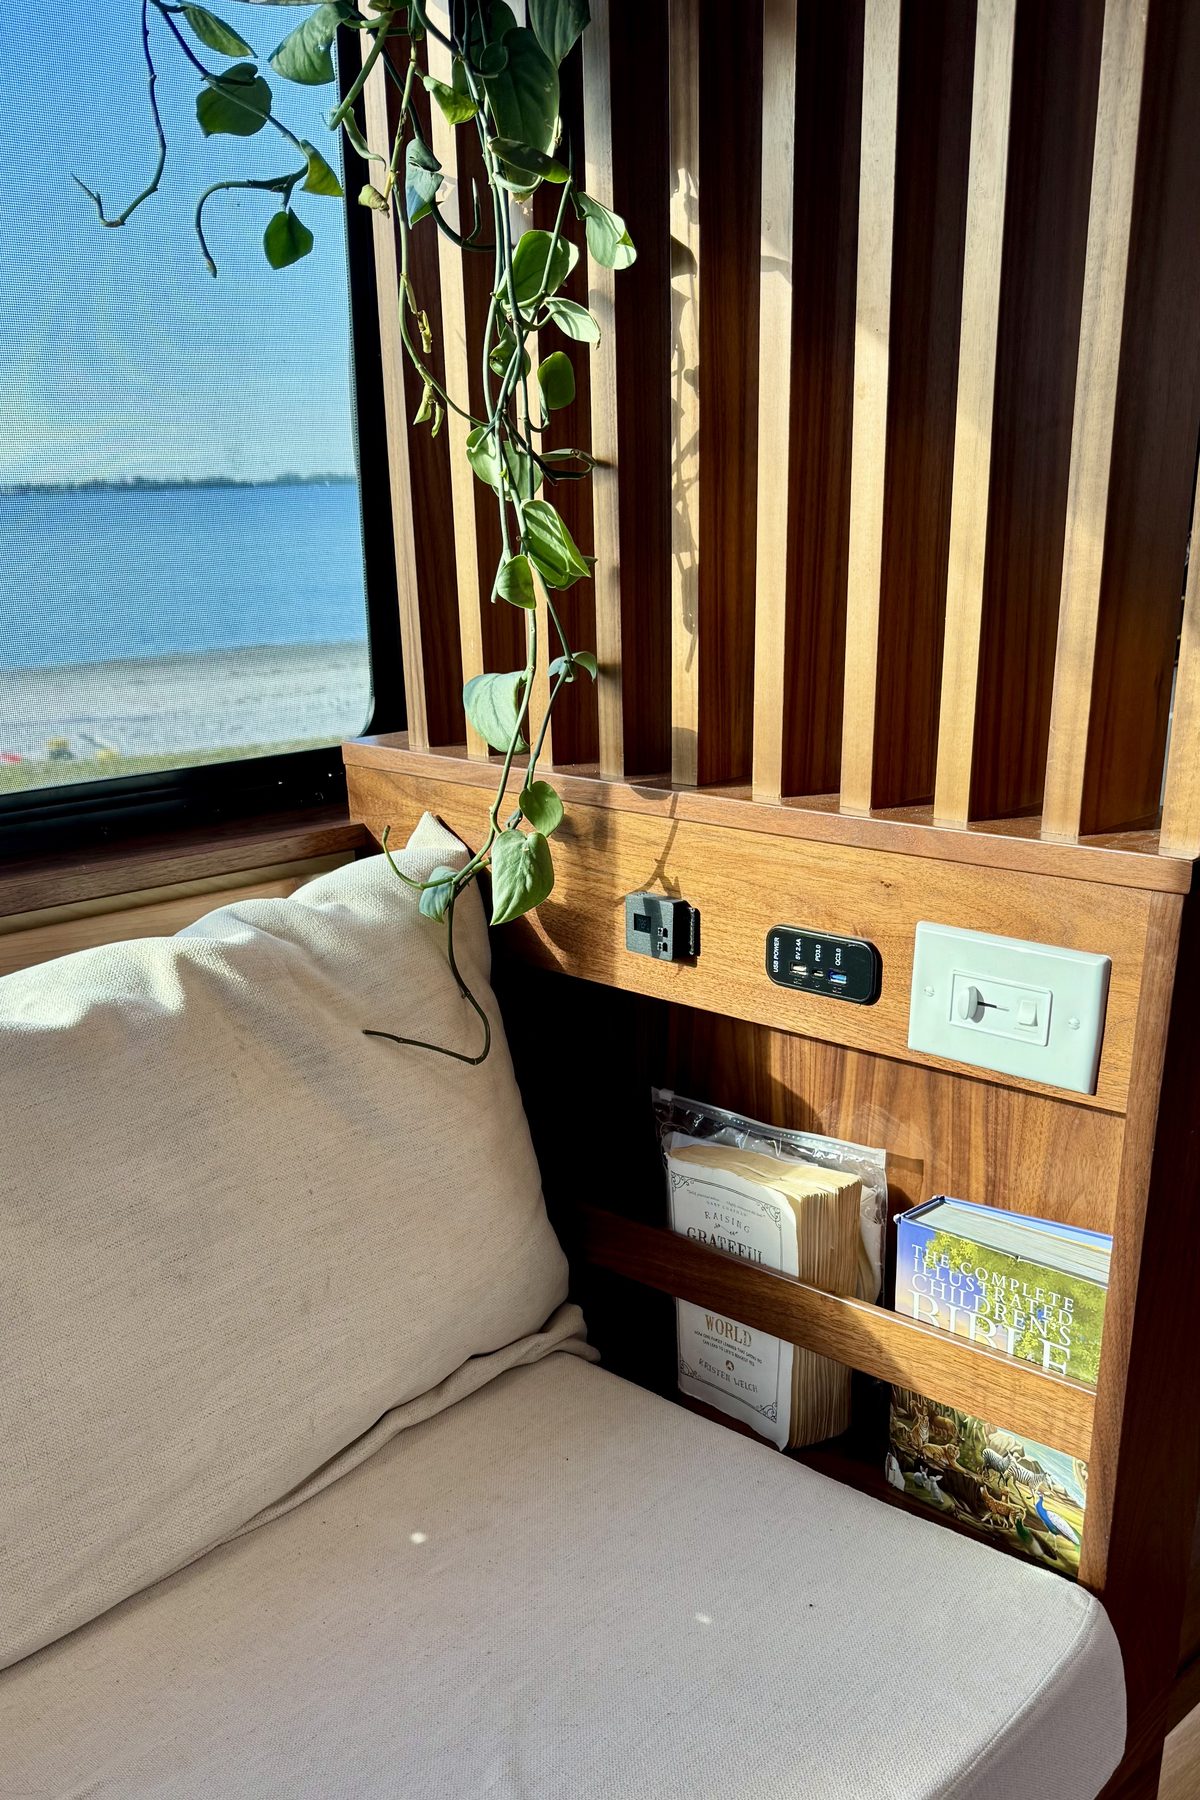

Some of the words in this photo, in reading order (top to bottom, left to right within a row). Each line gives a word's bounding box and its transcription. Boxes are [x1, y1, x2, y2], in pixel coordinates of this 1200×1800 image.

[704, 1211, 751, 1234] RAISING
[911, 1244, 951, 1268] THE
[960, 1262, 1074, 1313] COMPLETE
[912, 1257, 1073, 1326] ILLUSTRATED
[704, 1313, 752, 1347] WORLD
[698, 1357, 731, 1383] KRISTEN
[733, 1376, 758, 1393] WELCH
